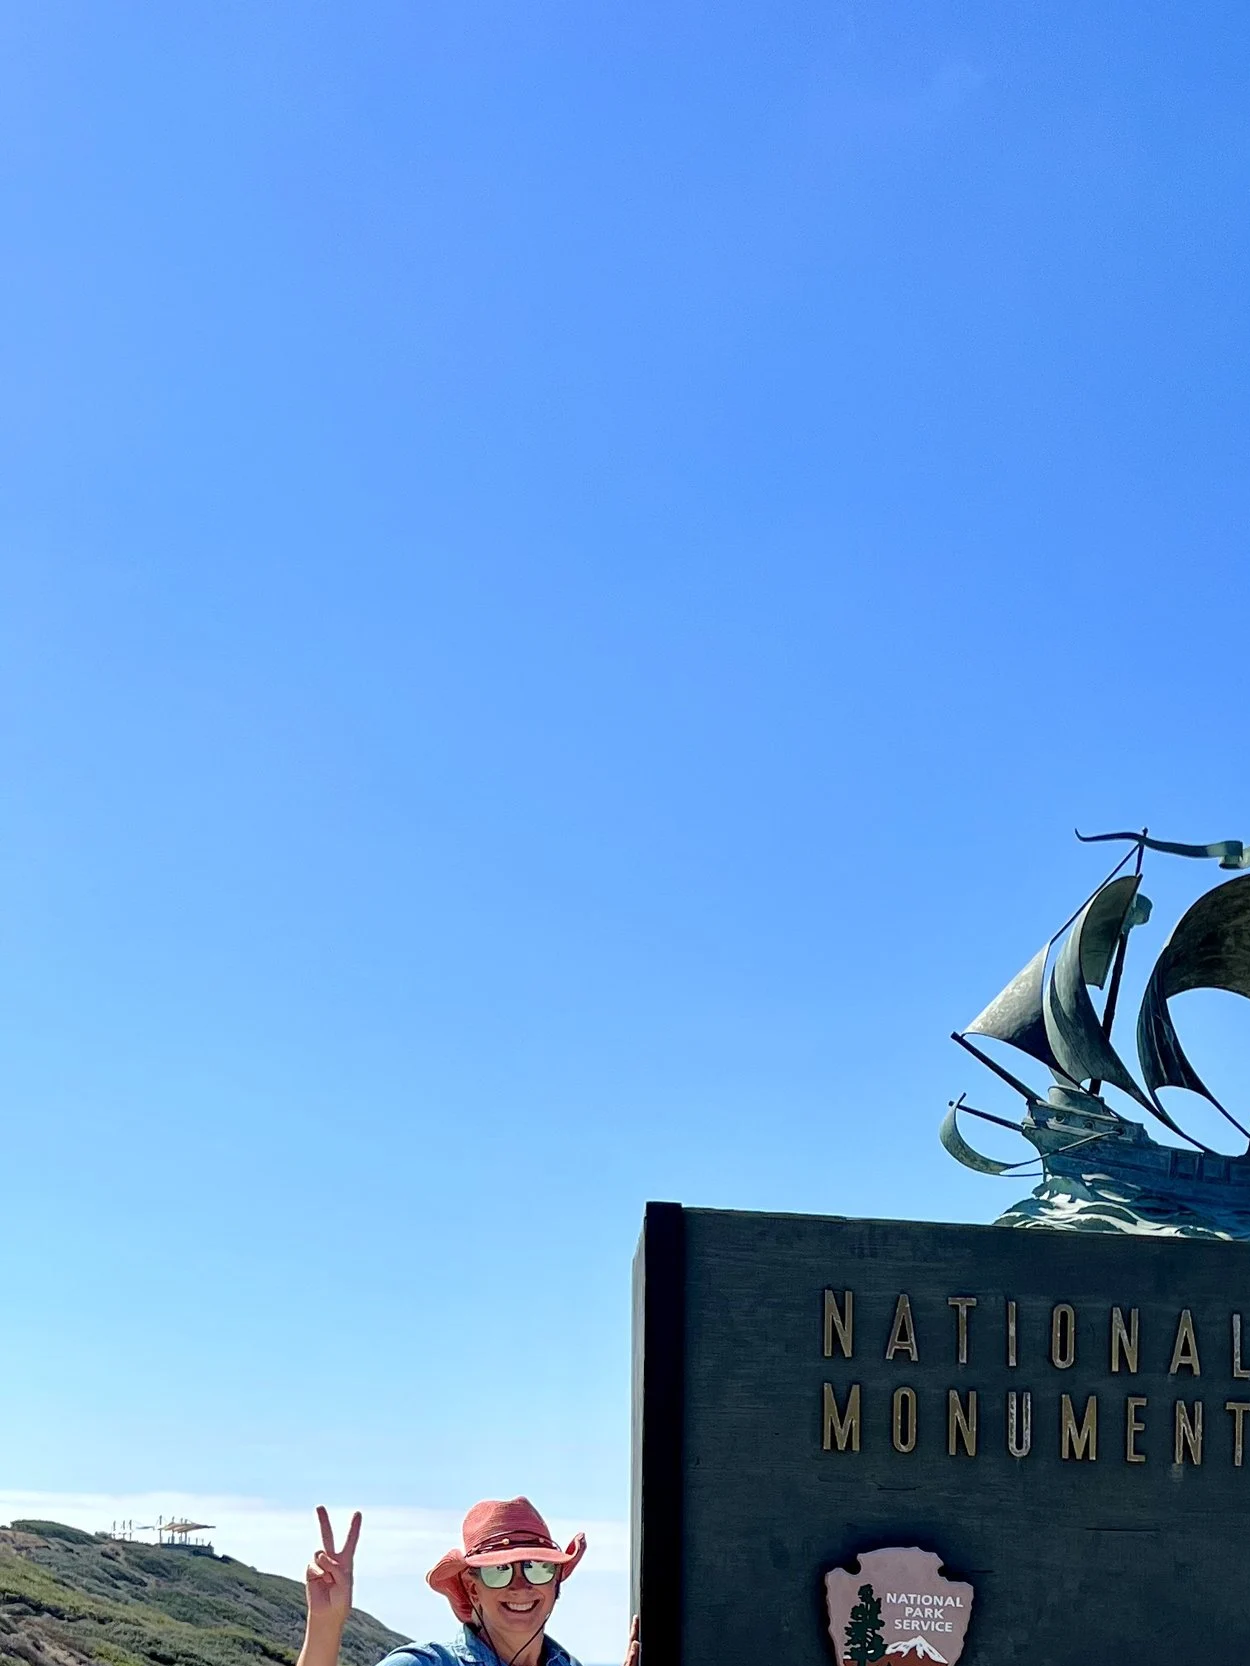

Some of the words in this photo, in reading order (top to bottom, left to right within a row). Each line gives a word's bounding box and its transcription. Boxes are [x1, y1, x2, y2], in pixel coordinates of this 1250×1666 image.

[886, 1592, 964, 1608] NATIONAL
[905, 1606, 943, 1619] PARK
[894, 1619, 953, 1632] SERVICE
